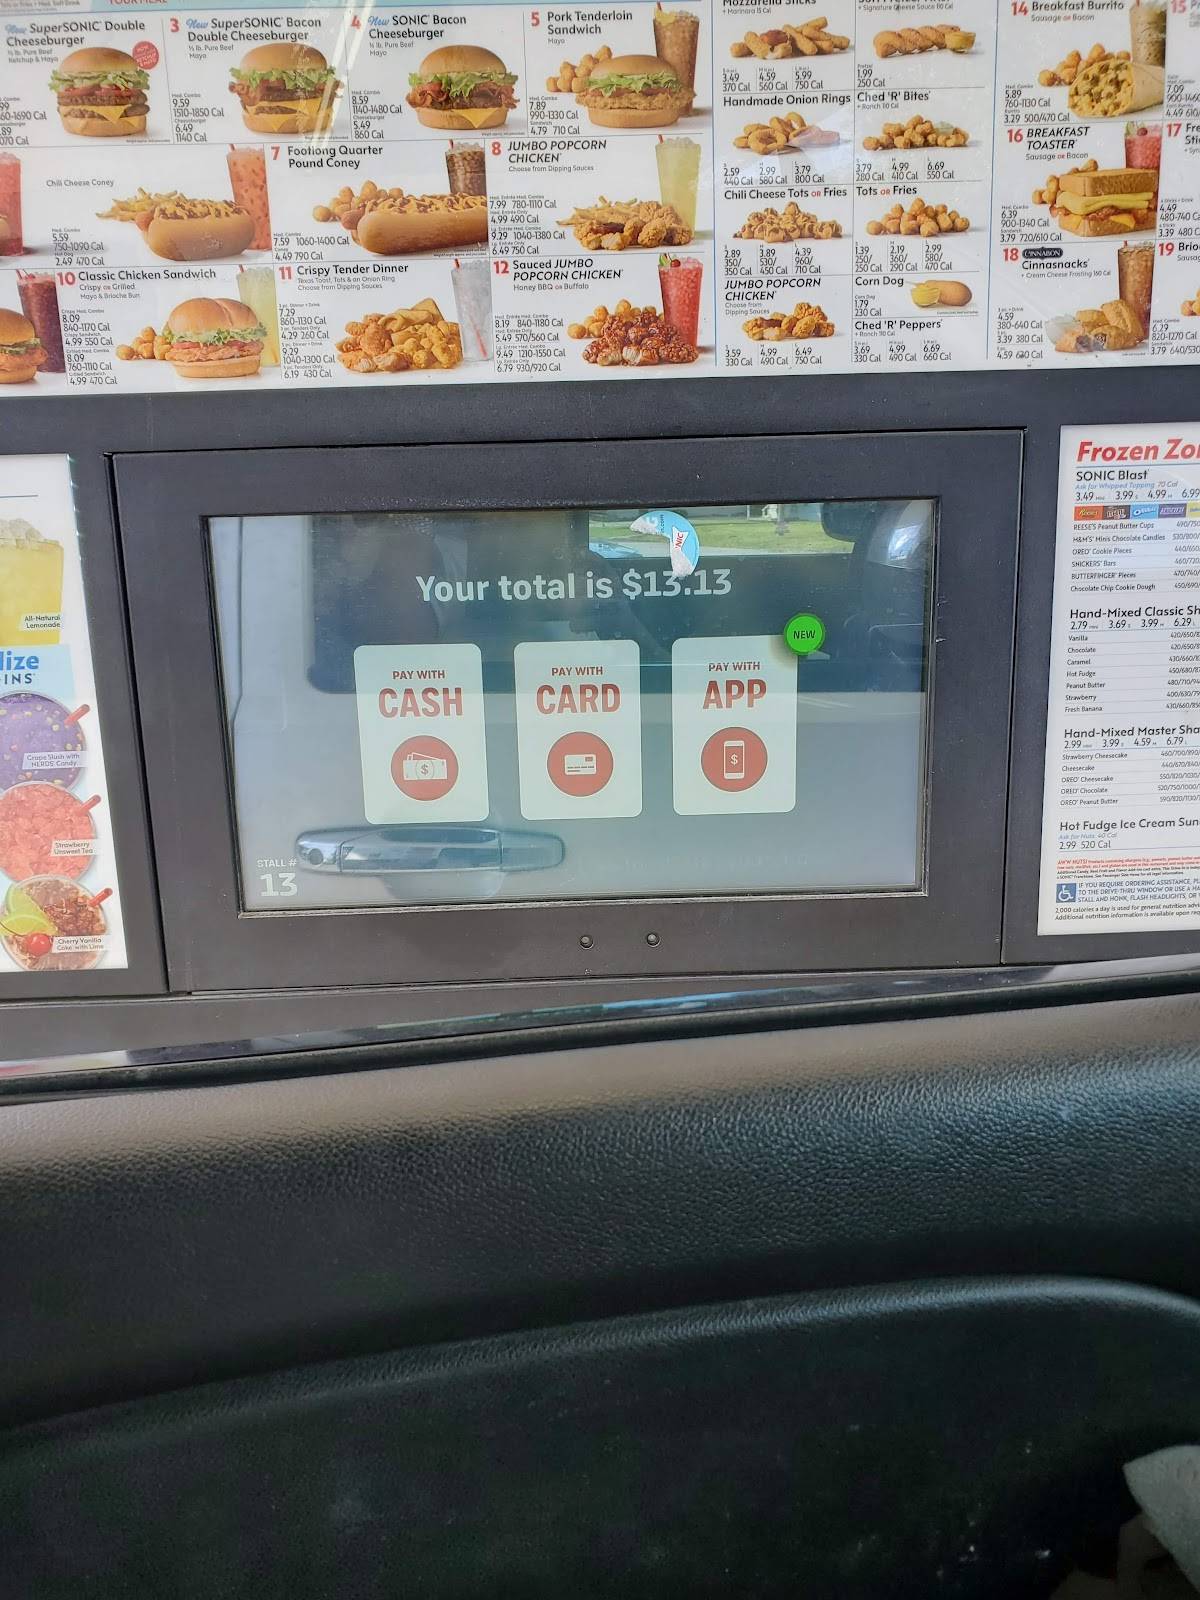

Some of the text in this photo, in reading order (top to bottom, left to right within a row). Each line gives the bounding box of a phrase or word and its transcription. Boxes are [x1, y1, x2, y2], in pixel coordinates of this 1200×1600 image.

[1012, 2, 1029, 16] 14
[1032, 0, 1124, 11] Breakfast Burrito
[368, 15, 467, 26] New SONIC Bacon
[531, 12, 540, 26] 5
[548, 11, 632, 22] Pork Tenderloin
[30, 20, 100, 34] SuperSONIC
[105, 20, 145, 31] Double
[170, 18, 180, 32] 3
[186, 17, 321, 30] New SuperSONIC Bacon
[351, 16, 361, 29] 4
[369, 28, 444, 40] Cheeseburger
[548, 25, 602, 35] Sandwich
[7, 36, 85, 47] Cheeseburger
[188, 30, 308, 42] Double Cheeseburger
[857, 69, 872, 78] 1.99
[858, 92, 885, 102] Ched
[904, 91, 928, 101] Bites
[1005, 90, 1022, 98] 5.89
[172, 99, 190, 107] 9.59
[352, 96, 368, 104] 8.59
[724, 94, 850, 107] Handmade Onion Rings
[529, 102, 546, 110] 7.89
[175, 124, 193, 132] 6.49
[353, 121, 370, 129] 5.49
[530, 127, 548, 135] 4.79
[553, 126, 566, 135] 710
[568, 126, 580, 134] Cal
[1166, 123, 1182, 137] 17
[354, 131, 370, 139] 860
[371, 130, 384, 139] Cal
[1007, 128, 1023, 143] 16
[1026, 126, 1090, 138] BREAKFAST
[491, 142, 501, 155] 8
[508, 140, 607, 151] JUMBO POPCORN
[1027, 140, 1075, 150] TOASTER
[271, 147, 280, 160] 7
[288, 145, 383, 157] Footlong Quarter
[289, 158, 360, 169] Pound Coney
[508, 154, 560, 163] CHICKEN
[46, 179, 62, 187] Chili
[91, 179, 114, 187] Coney
[725, 190, 747, 200] Chili
[749, 190, 785, 199] Cheese
[788, 189, 808, 198] Tots
[824, 187, 847, 196] Fries
[856, 187, 878, 196] Tots
[893, 186, 917, 195] Fries
[490, 199, 557, 209] 7.99 780-1110 Cal
[1001, 210, 1018, 218] 6.39
[52, 234, 69, 242] 5.59
[273, 236, 349, 246] 7.59 1060-1400 Cal
[925, 244, 942, 252] 2.99
[1159, 243, 1174, 256] 19
[275, 251, 323, 261] 4.49 790 Cal
[1003, 248, 1019, 262] 18
[494, 261, 509, 274] 12
[513, 259, 593, 269] Sauced JUMBO
[1022, 260, 1088, 270] Cinnasnacks
[79, 269, 216, 281] Classic Chicken Sandwich
[279, 267, 292, 280] 11
[297, 264, 408, 277] Crispy Tender Dinner
[513, 270, 621, 281] POPCORN CHICKEN
[56, 272, 75, 286] 10
[725, 278, 821, 289] JUMBO POPCORN
[856, 276, 904, 287] Corn Dog
[725, 291, 775, 301] CHICKEN
[855, 321, 881, 330] Ched
[900, 320, 941, 331] Peppers
[1077, 441, 1159, 462] Frozen
[1076, 470, 1148, 481] SONIC Blast
[675, 533, 683, 548] NIC
[416, 567, 732, 602] Your total is $13.13
[1070, 584, 1100, 592] Chocolate
[1101, 584, 1114, 592] Chip
[1136, 583, 1155, 591] Dough
[1070, 606, 1184, 619] Hand-Mixed Classic
[1070, 618, 1192, 629] 2.79 3.69 3.99 6.29
[792, 629, 815, 640] NEW
[551, 666, 603, 676] PAY WITH
[708, 661, 760, 672] PAY WITH
[392, 669, 446, 680] PAY WITH
[536, 683, 621, 714] CARD
[702, 679, 767, 710] APP
[378, 687, 463, 718] CASH
[1064, 727, 1176, 738] Hand-Mixed Master
[1060, 819, 1176, 831] Hot Fudge Ice Cream
[1098, 840, 1111, 848] Cal
[257, 859, 286, 868] STALL
[260, 873, 298, 896] 13
